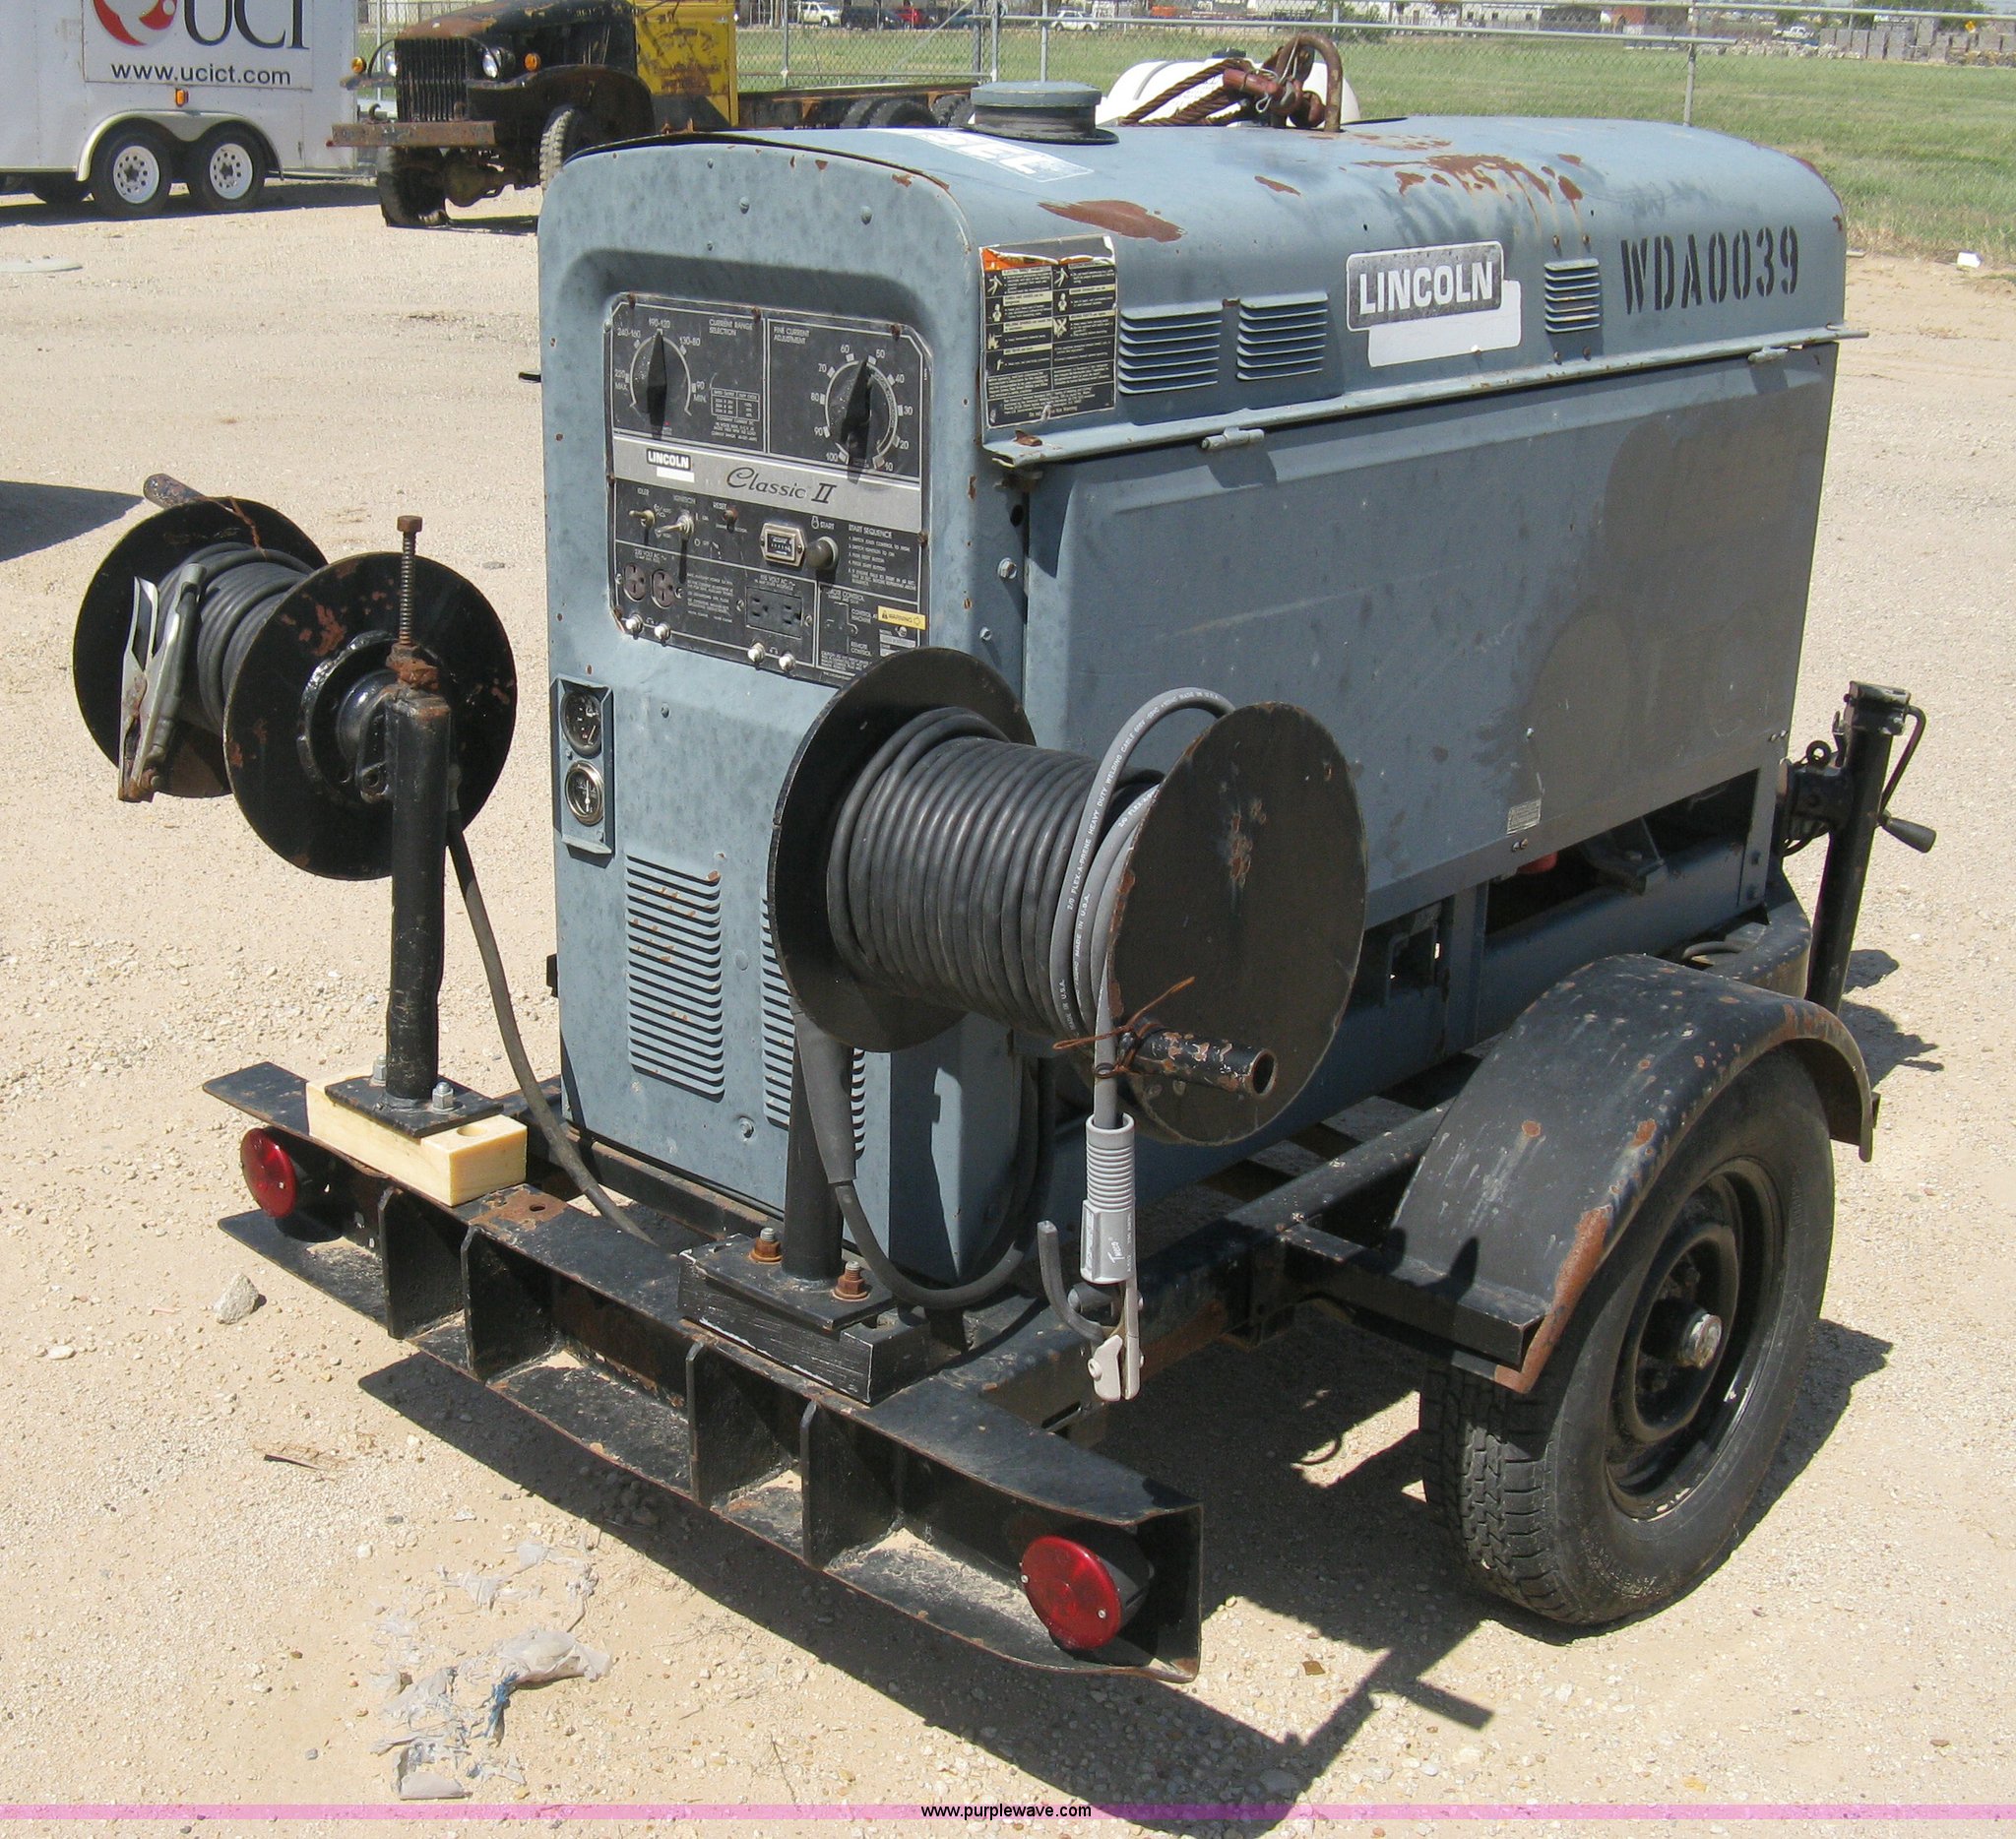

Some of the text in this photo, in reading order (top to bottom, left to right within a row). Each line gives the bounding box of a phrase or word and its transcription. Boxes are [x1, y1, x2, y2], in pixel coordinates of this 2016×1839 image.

[183, 0, 310, 49] UCI
[111, 63, 291, 86] www.ucict.com
[1619, 224, 1798, 315] WDA0039
[1358, 260, 1493, 315] LINCOLN
[840, 345, 850, 354] 60
[818, 362, 827, 373] 70
[895, 374, 905, 384] 40
[904, 406, 914, 416] 30
[814, 426, 823, 437] 90
[900, 439, 910, 450] 20
[648, 450, 689, 469] LINCOLN
[826, 452, 838, 463] 100
[726, 467, 837, 505] Classic II
[1088, 809, 1101, 836] HEAVY
[1097, 787, 1108, 807] DUTY
[1105, 754, 1123, 786] WELDING
[1120, 731, 1136, 753] CABLE
[1078, 920, 1084, 930] IN
[1082, 893, 1091, 918] U.S.A.
